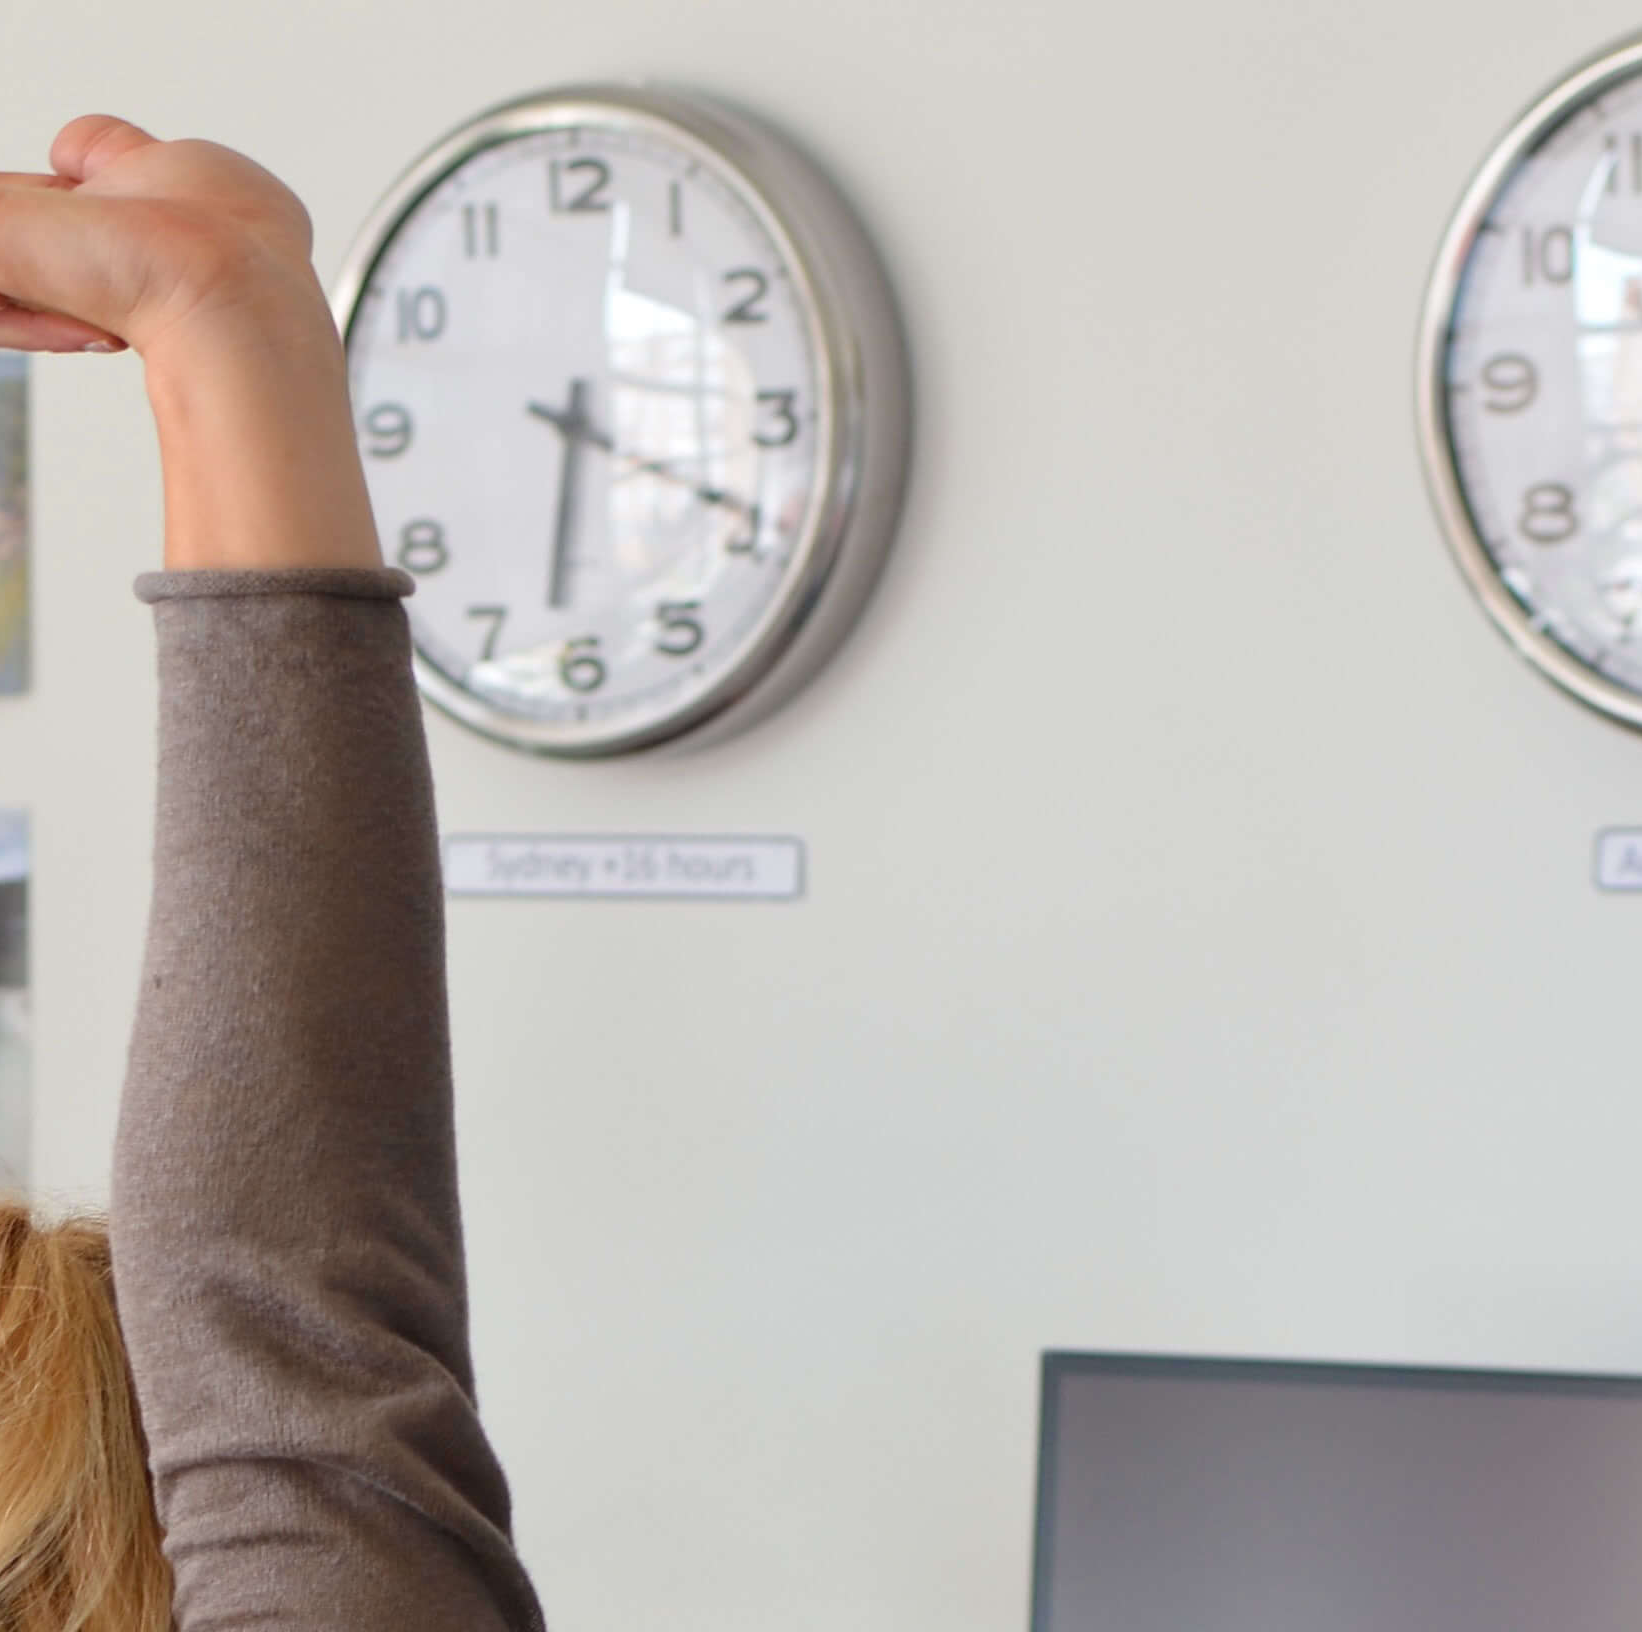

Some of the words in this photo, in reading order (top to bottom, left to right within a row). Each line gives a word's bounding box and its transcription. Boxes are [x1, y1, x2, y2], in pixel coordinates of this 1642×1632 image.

[547, 158, 613, 214] 12
[668, 181, 682, 237] 1
[461, 203, 499, 258] 11
[1520, 225, 1575, 287] 10
[395, 287, 447, 343] 10
[722, 269, 771, 325] 2
[1481, 353, 1538, 414] 9
[364, 403, 413, 459] 9
[753, 389, 798, 448] 3
[1519, 481, 1581, 545] 8
[397, 519, 450, 575] 8
[467, 606, 509, 662] 7
[654, 602, 705, 657] 5
[557, 635, 607, 692] 6
[485, 842, 591, 886] Sydney
[667, 843, 755, 880] hours
